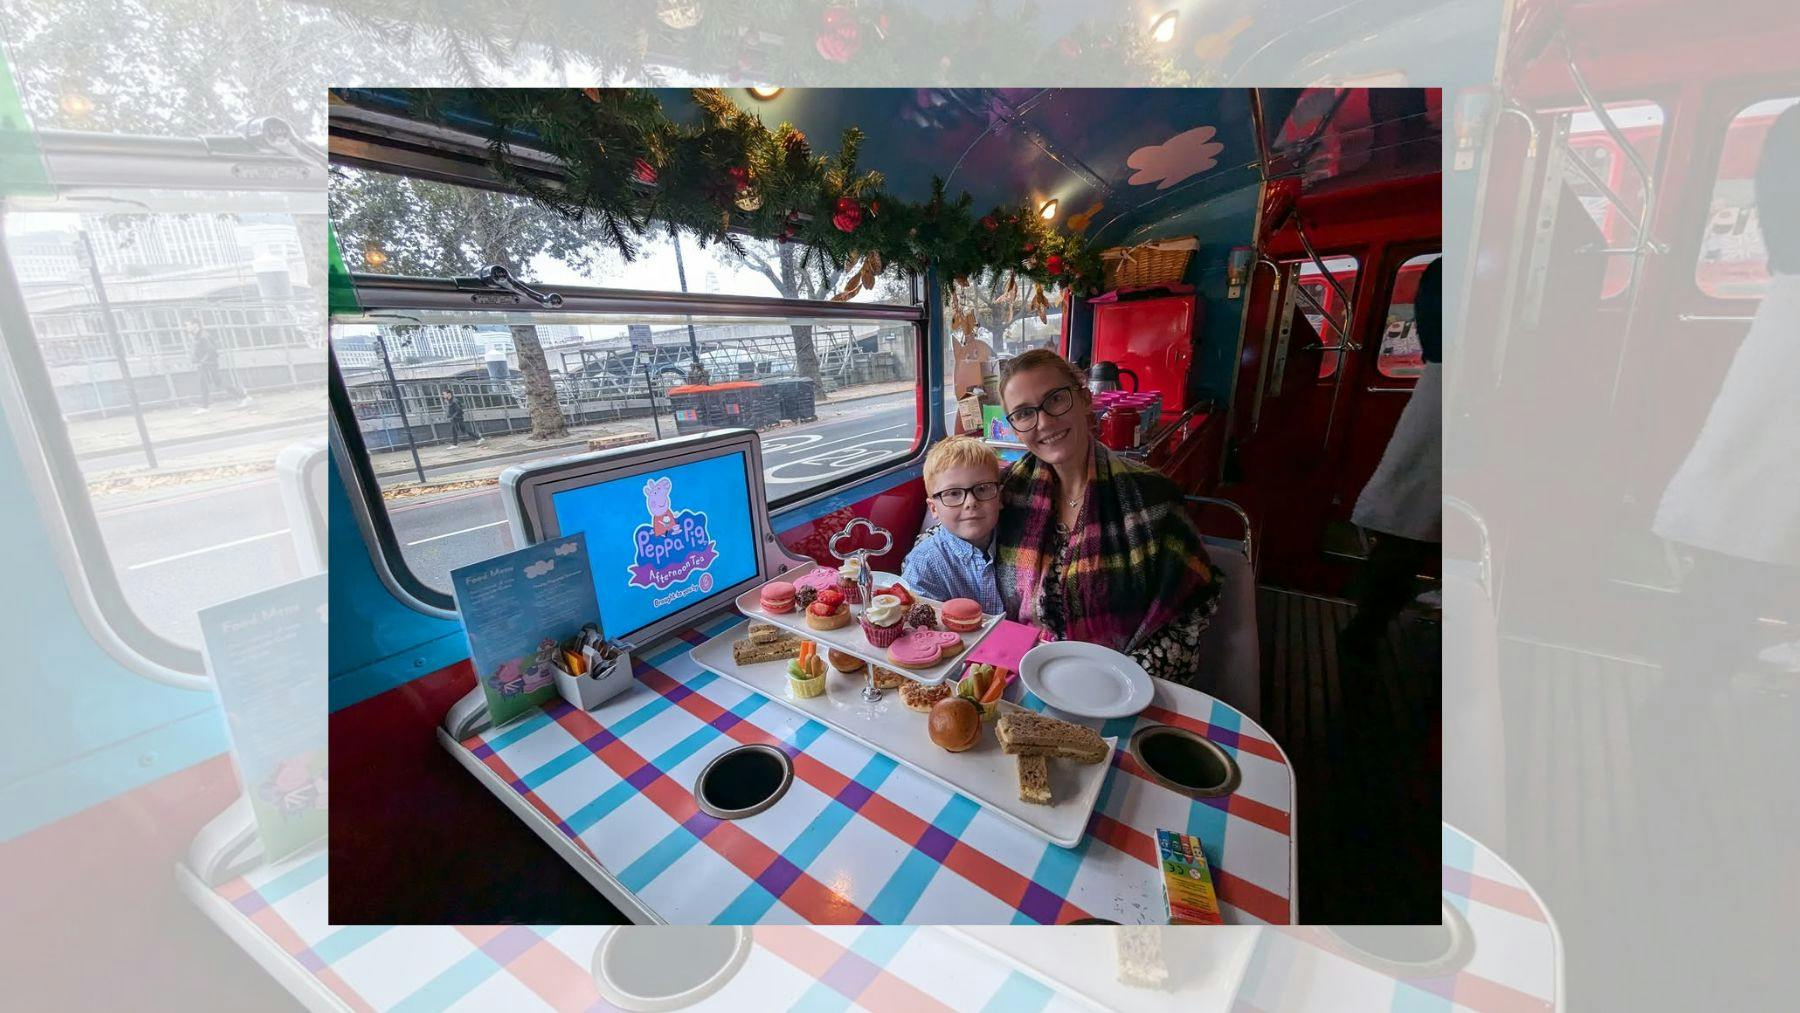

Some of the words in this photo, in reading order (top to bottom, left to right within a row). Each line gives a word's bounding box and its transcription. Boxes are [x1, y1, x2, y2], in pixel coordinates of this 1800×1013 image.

[637, 530, 684, 564] Peppa
[683, 518, 705, 547] Pig
[649, 561, 691, 583] Afternoon
[689, 554, 705, 567] Tea
